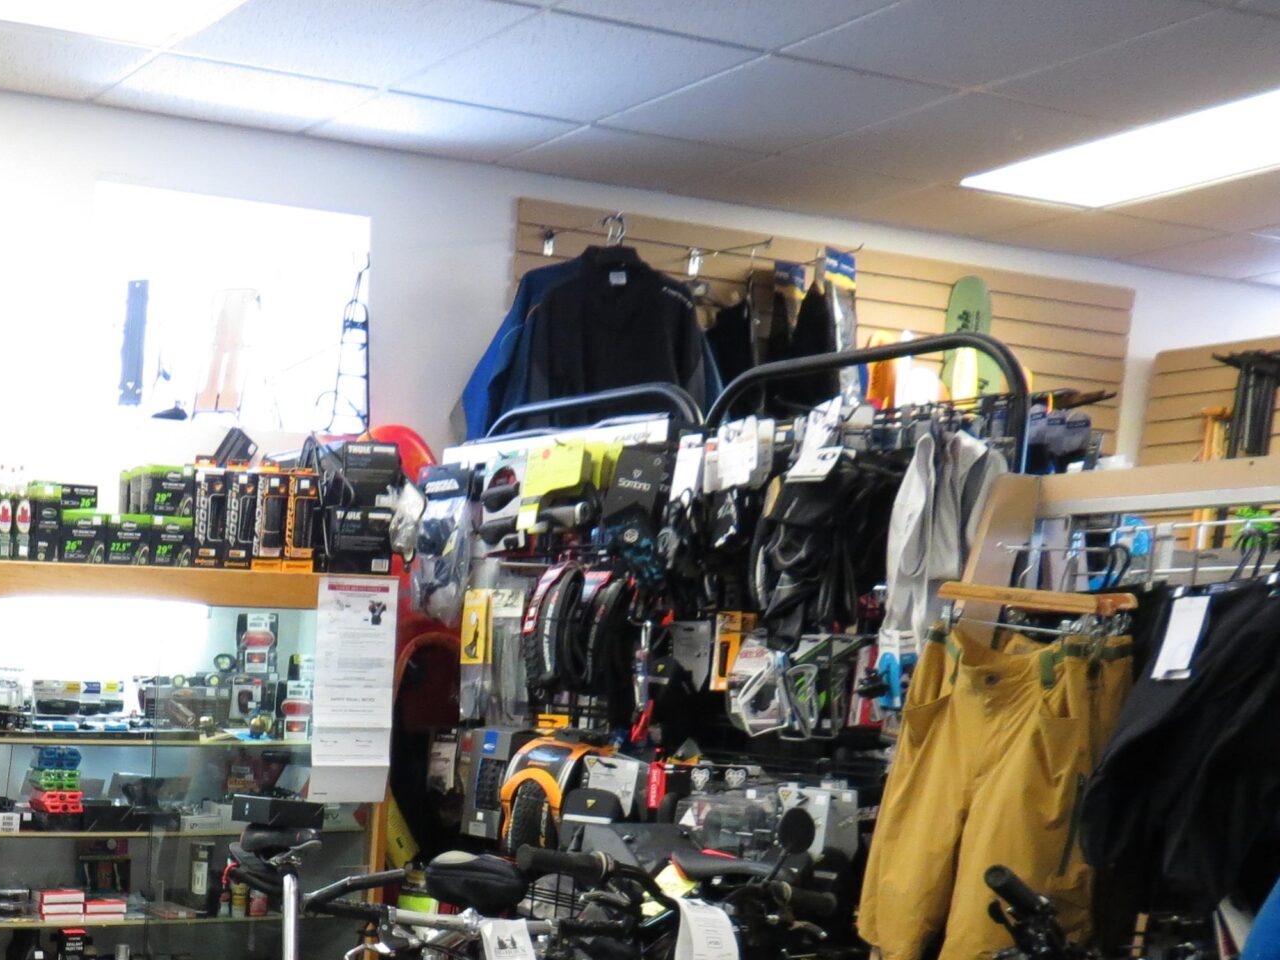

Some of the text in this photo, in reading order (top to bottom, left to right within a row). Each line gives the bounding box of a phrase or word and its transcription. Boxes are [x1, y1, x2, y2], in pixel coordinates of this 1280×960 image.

[348, 444, 371, 454] THULE
[80, 497, 96, 508] 26"
[65, 540, 83, 550] 26"
[110, 542, 132, 552] 27.5"
